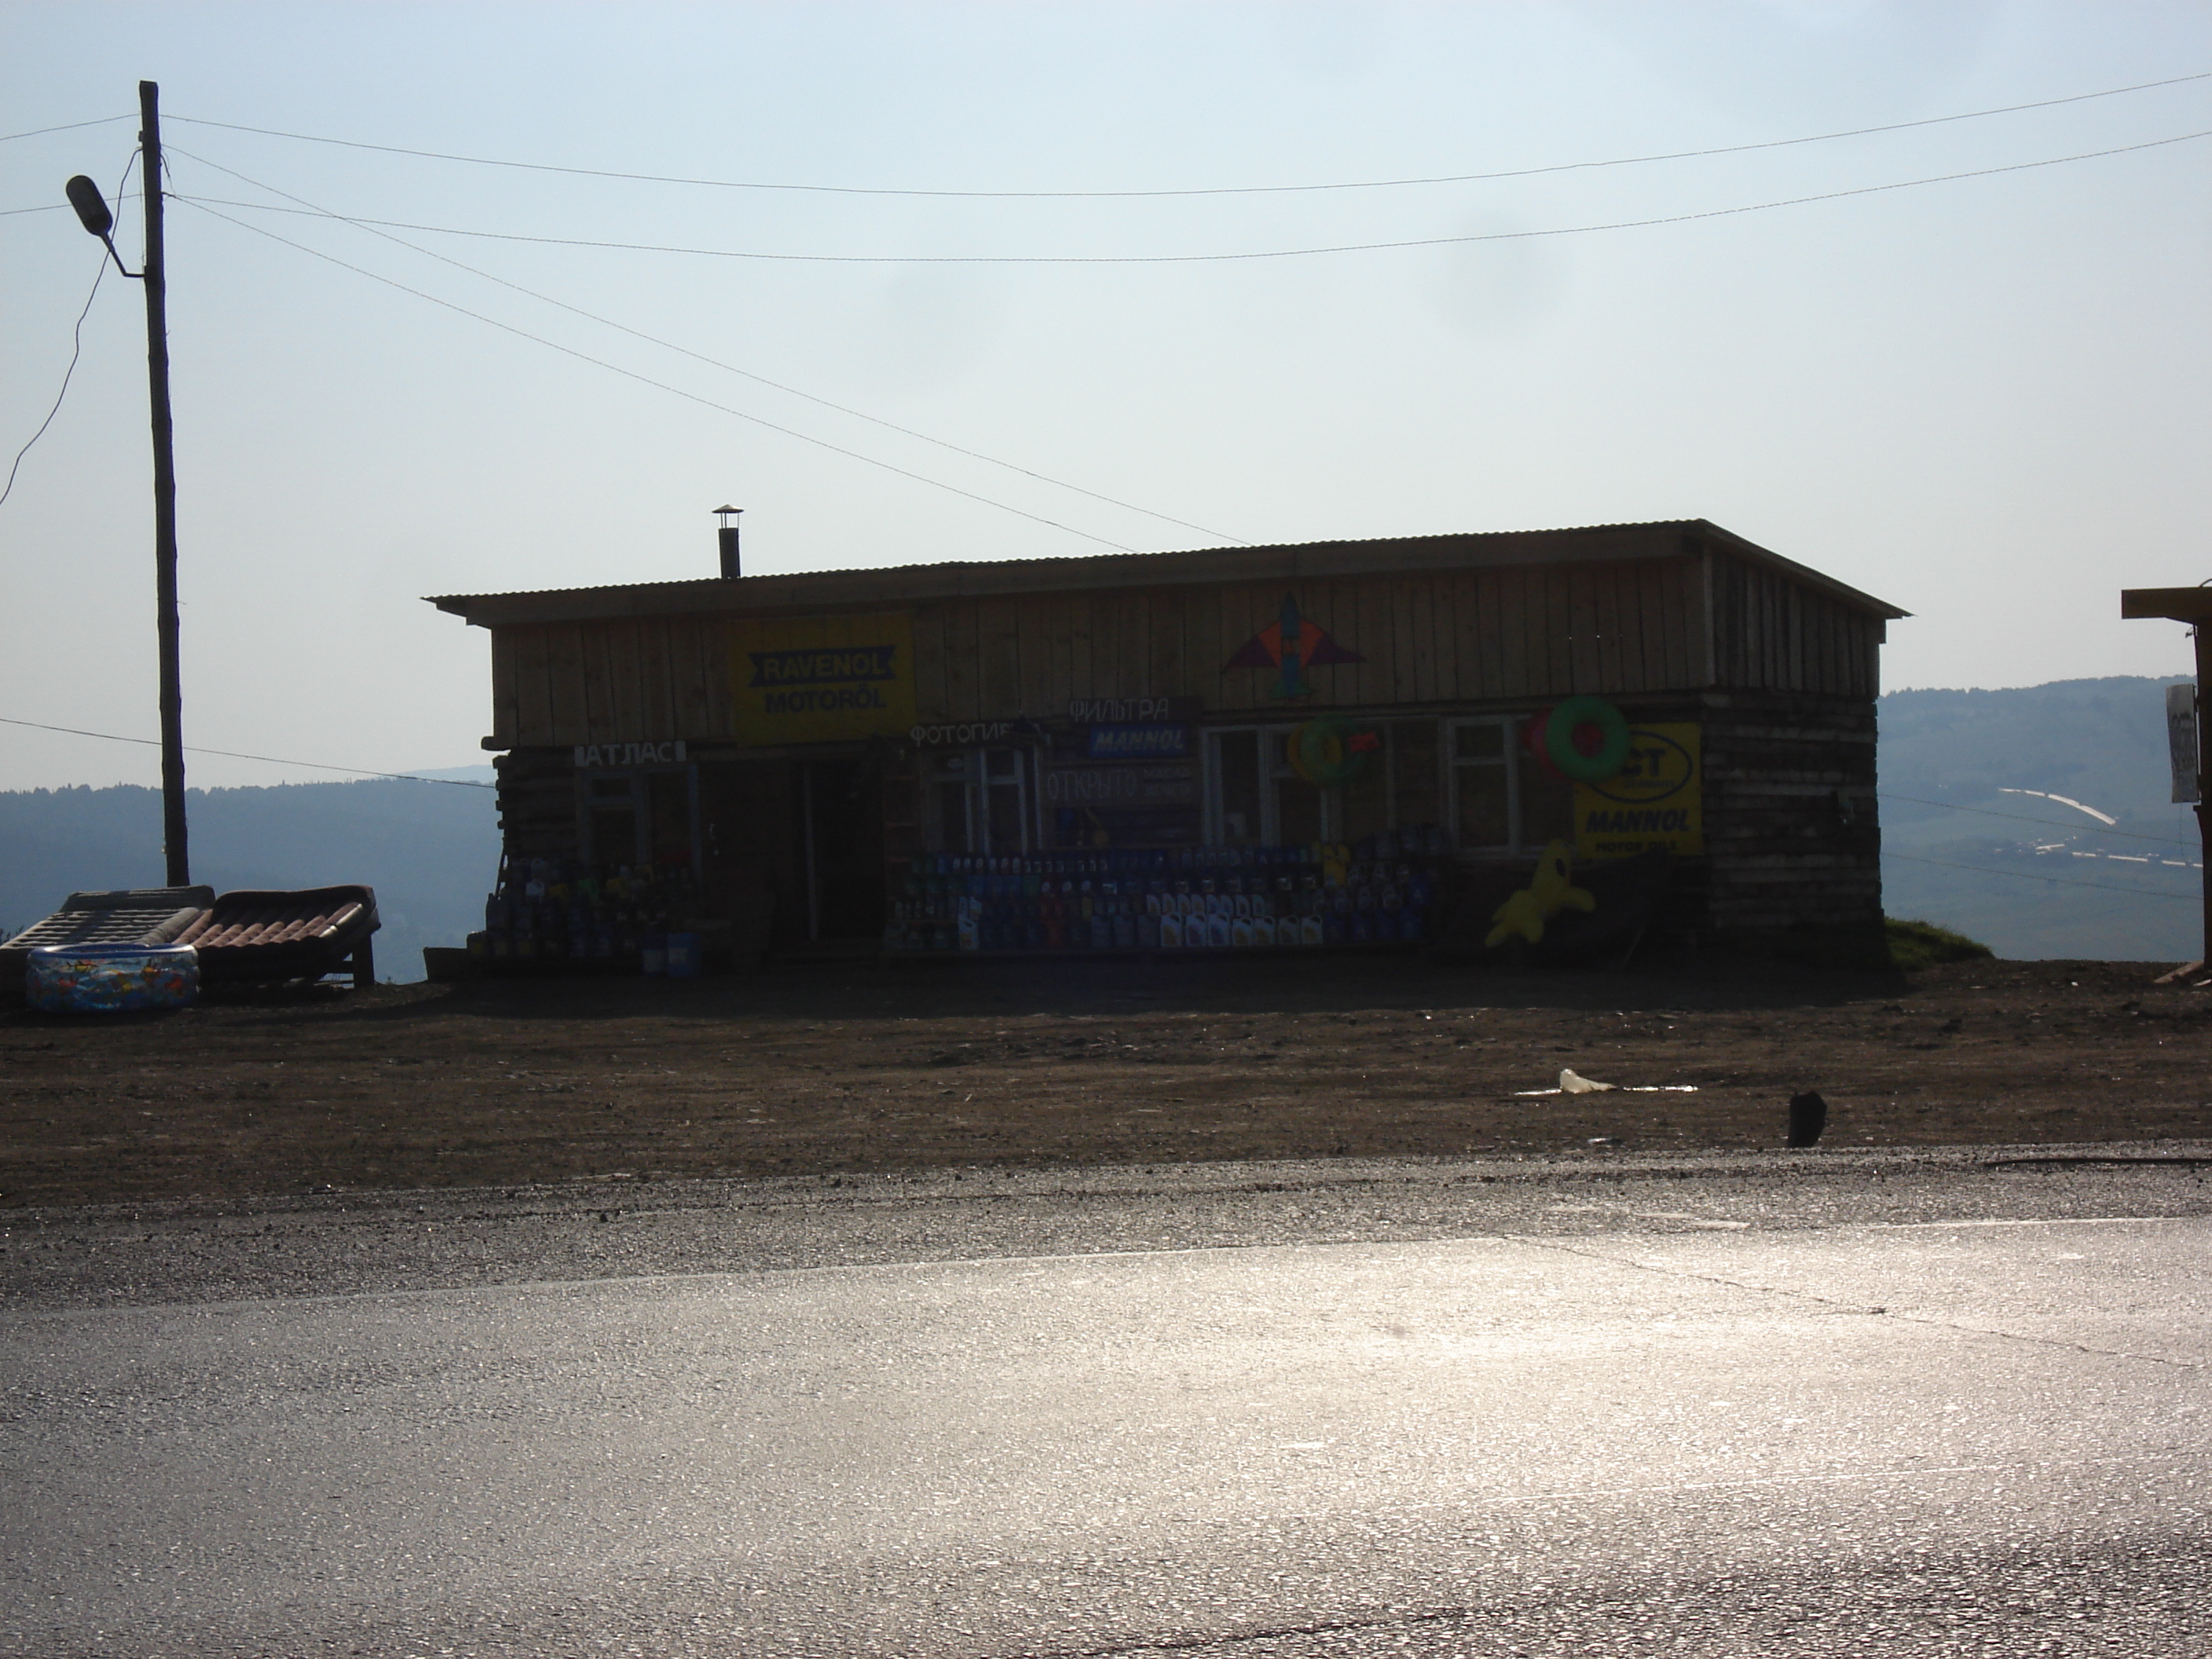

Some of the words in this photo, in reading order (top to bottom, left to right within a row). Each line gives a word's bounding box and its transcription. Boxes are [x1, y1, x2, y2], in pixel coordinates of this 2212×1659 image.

[763, 654, 886, 680] RAVENOL
[765, 683, 886, 713] MOTORÖL
[1069, 698, 1169, 723] ФИЛЬТРА
[1094, 730, 1185, 752] MANNOL
[585, 742, 673, 766] АТЛАС
[1047, 769, 1137, 800] ОТКРЫТО
[1586, 808, 1690, 833] MANNOL
[1595, 841, 1643, 852] MOTOR
